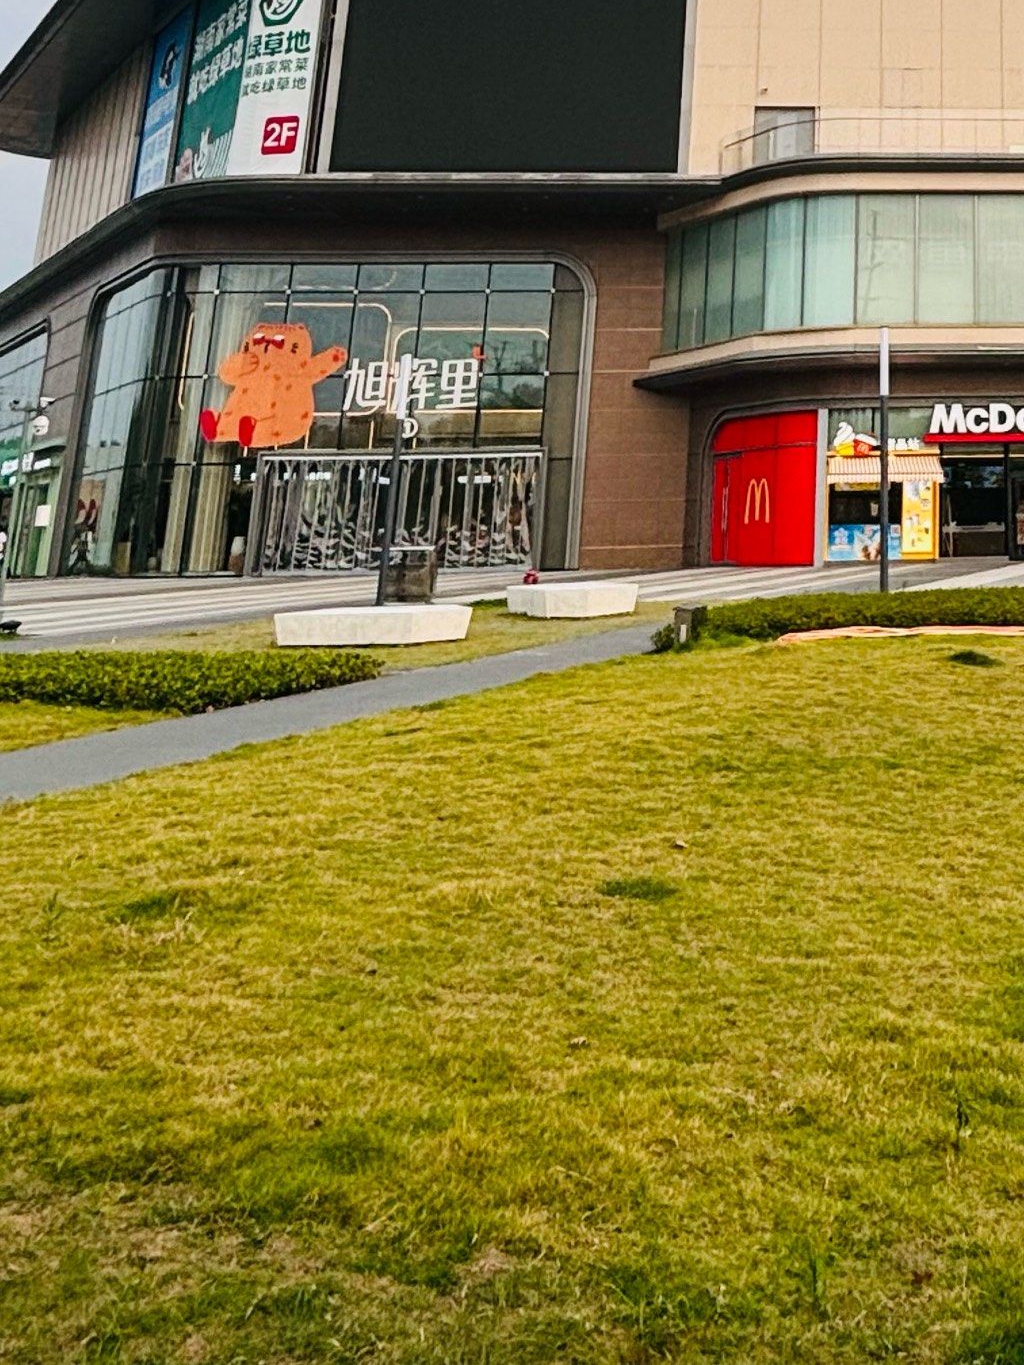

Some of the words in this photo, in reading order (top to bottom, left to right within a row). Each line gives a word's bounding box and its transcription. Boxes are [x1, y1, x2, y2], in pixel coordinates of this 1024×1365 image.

[263, 122, 297, 147] 2F
[342, 346, 486, 411] 旭辉里
